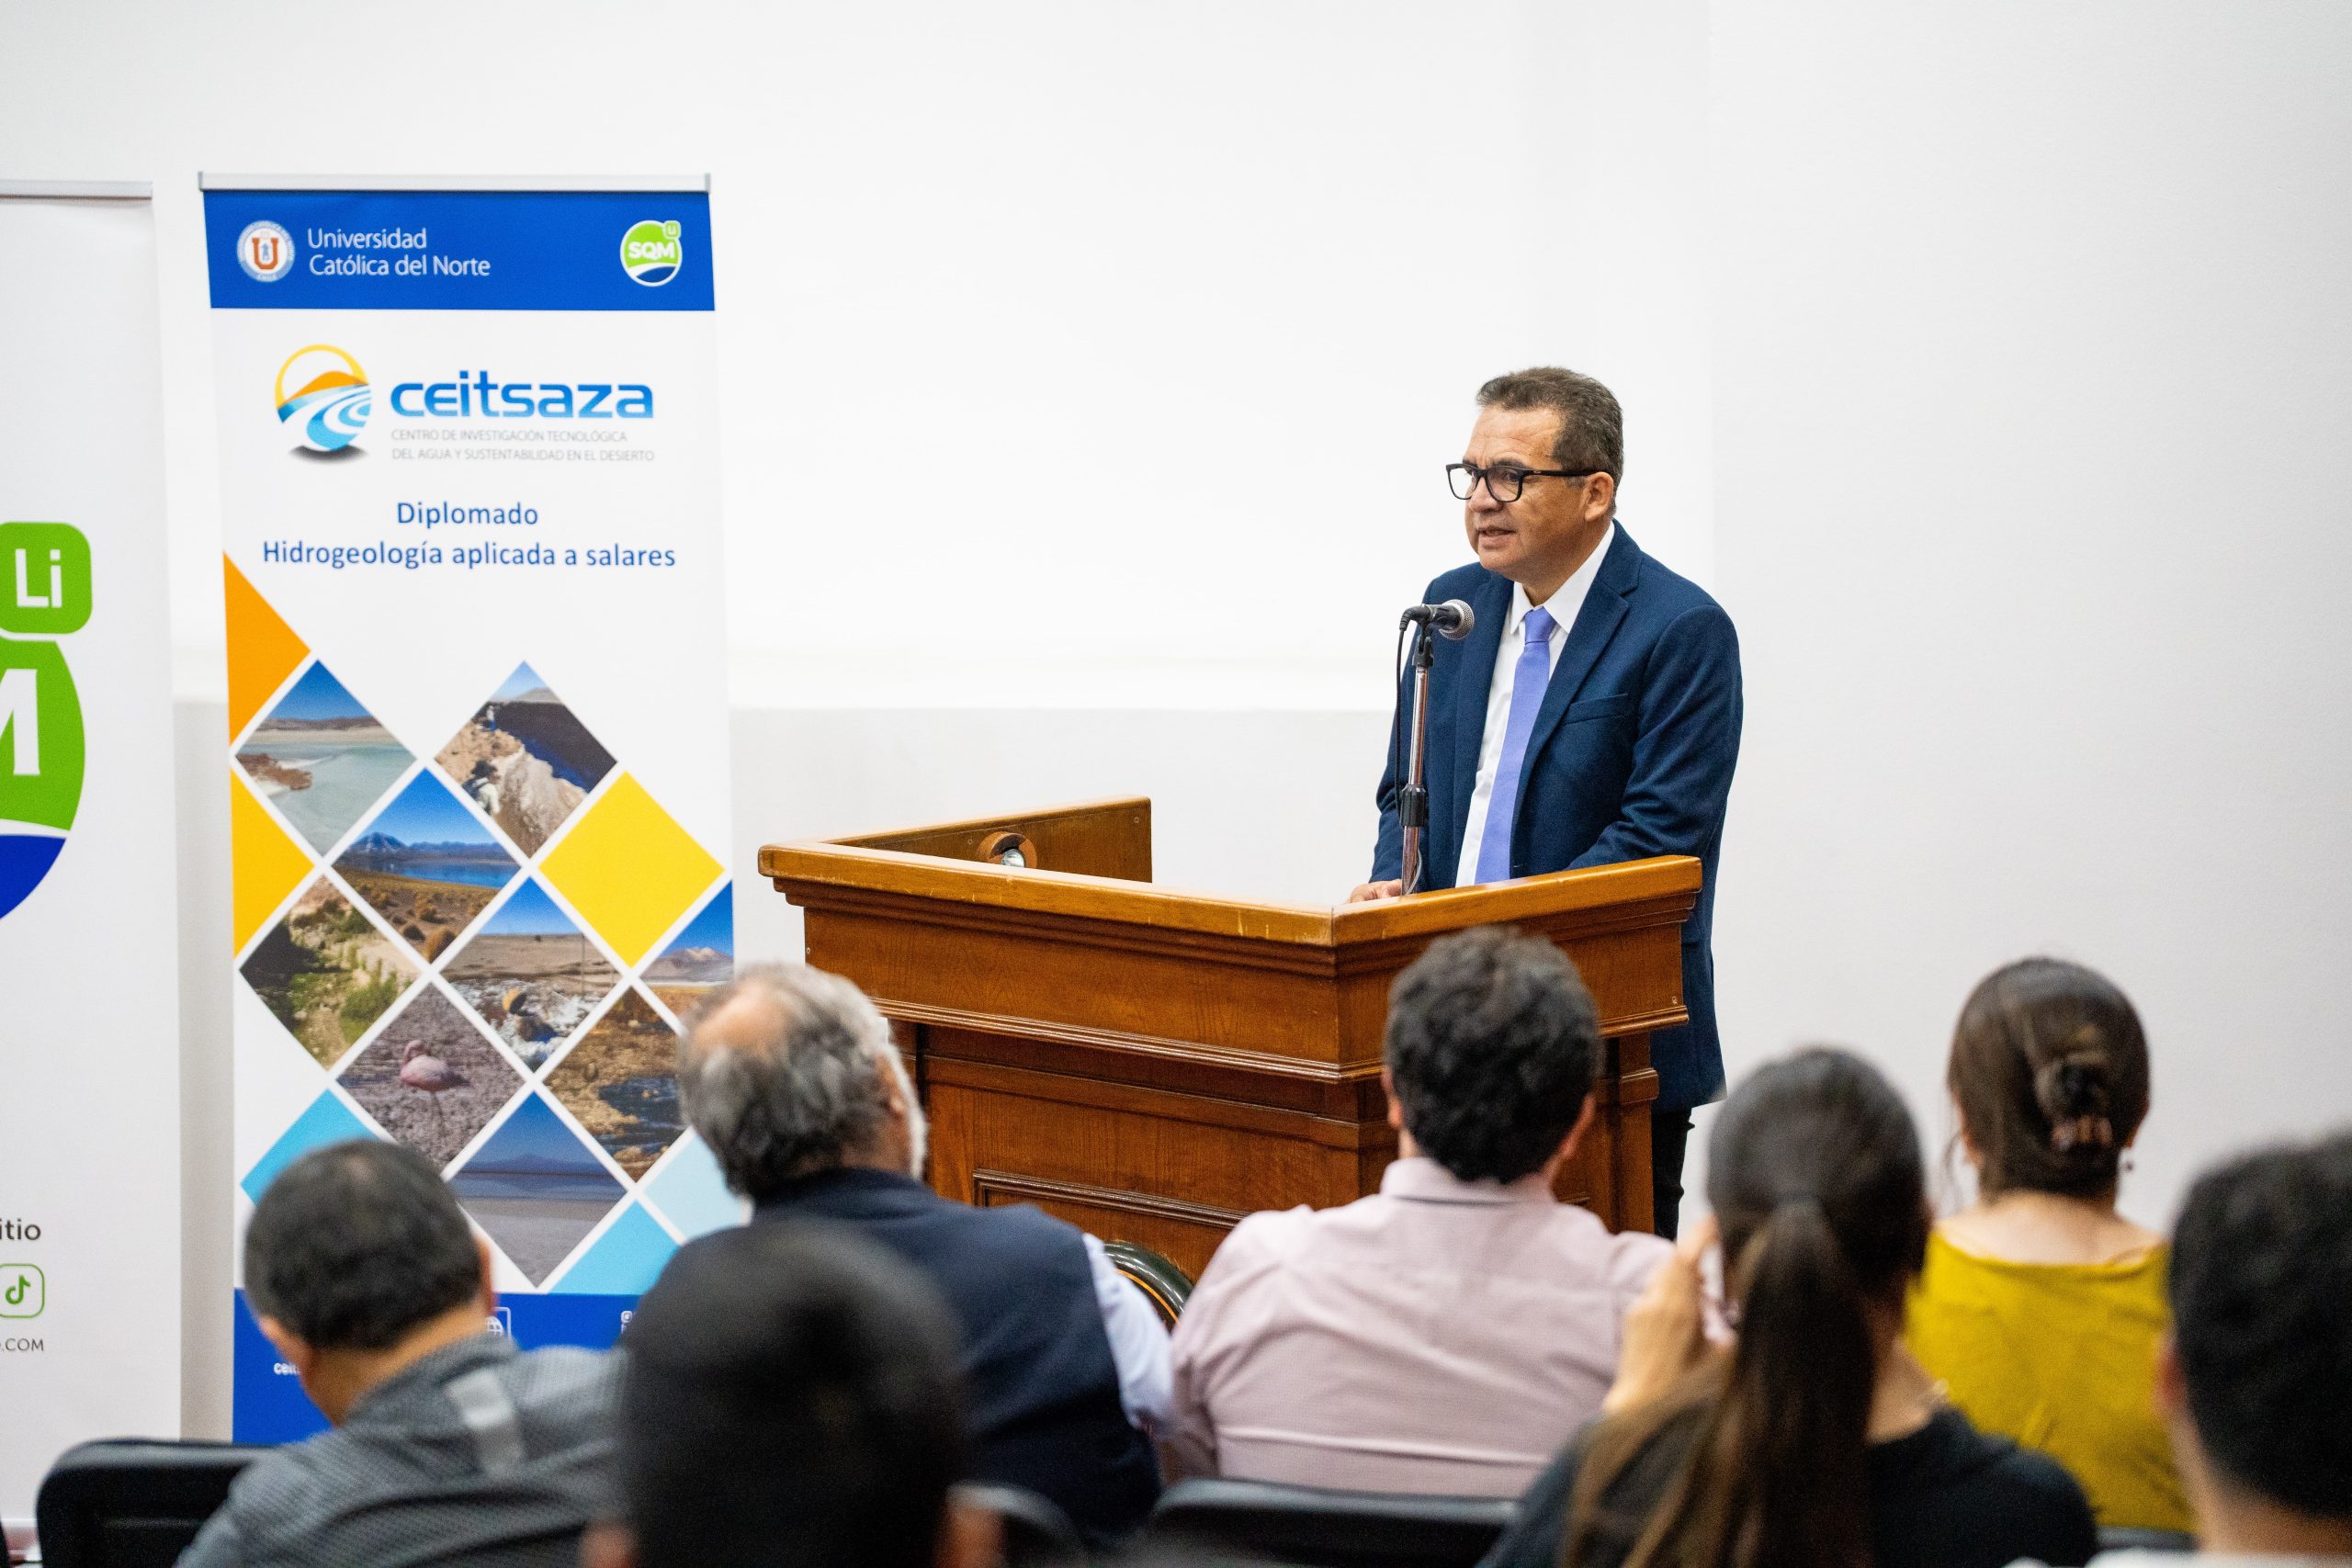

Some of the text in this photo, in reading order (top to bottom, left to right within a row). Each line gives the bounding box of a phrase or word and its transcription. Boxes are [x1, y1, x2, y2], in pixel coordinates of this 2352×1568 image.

[308, 227, 427, 249] Universidad
[628, 241, 675, 260] SQM
[309, 254, 491, 276] Católica del Norte
[390, 369, 654, 419] ceitsaza
[390, 428, 628, 442] CENTRO DE INVESTIGACIÓN TECNOLÓGICA
[392, 447, 655, 462] DEL AGUA Y SUSTENTABILIDAD EN EL DESIERTO
[397, 501, 538, 529] Diplomado
[264, 541, 676, 570] Hidrogeología aplicada a salares
[16, 548, 62, 608] Li
